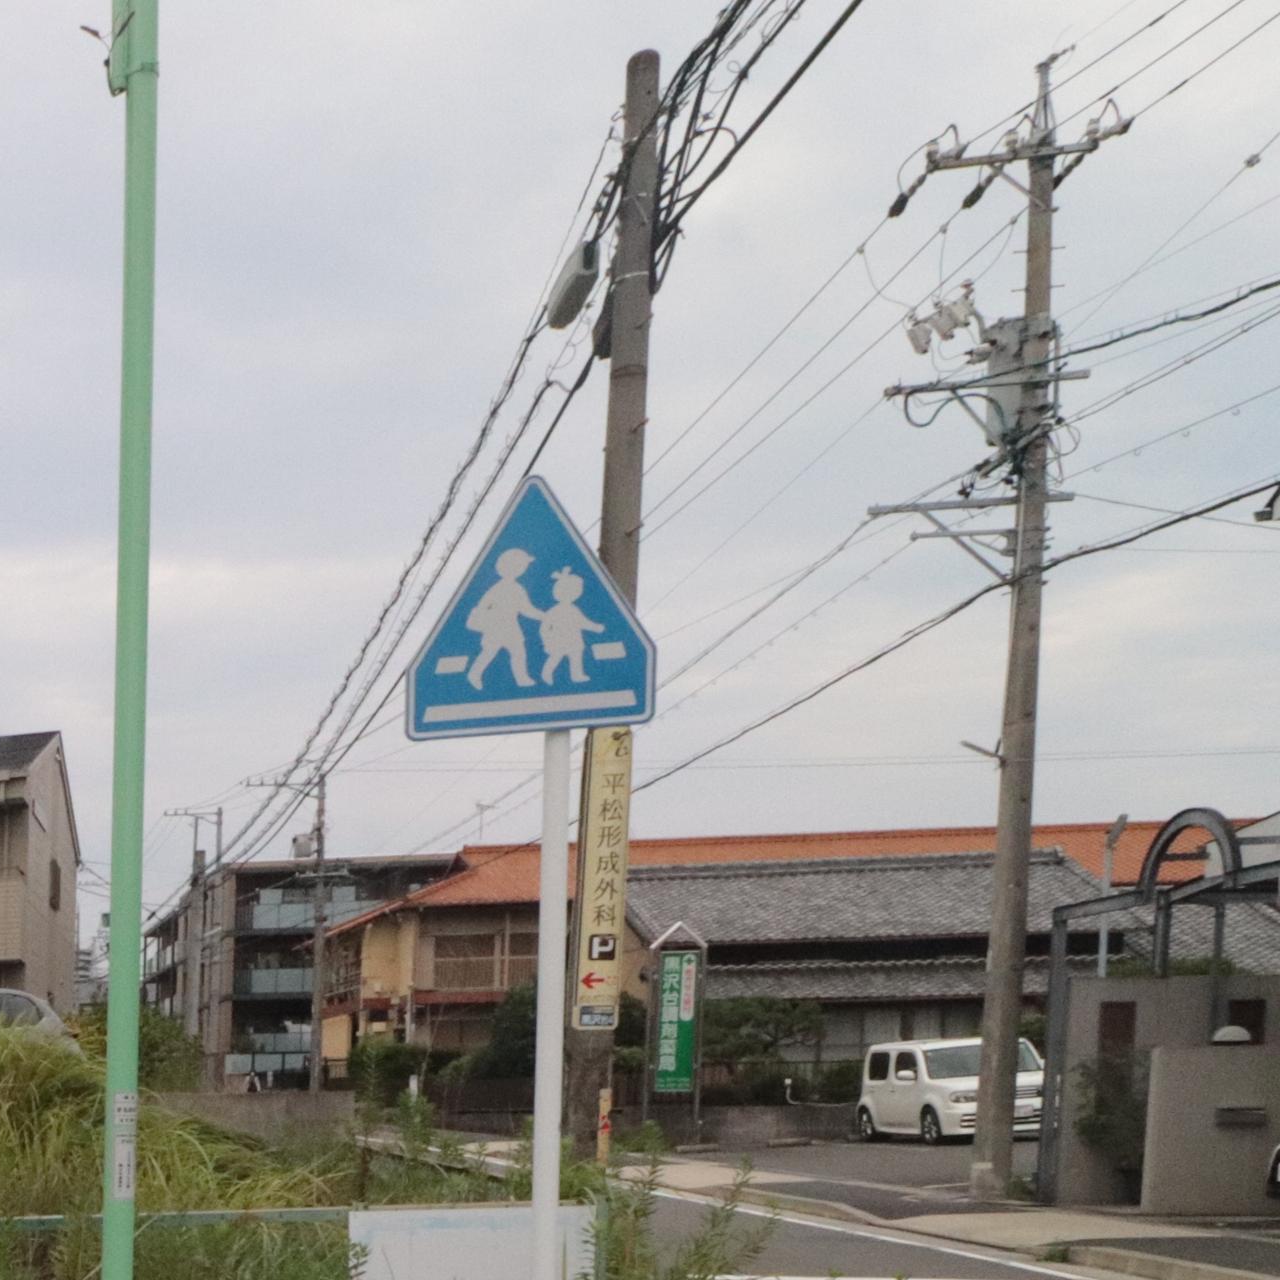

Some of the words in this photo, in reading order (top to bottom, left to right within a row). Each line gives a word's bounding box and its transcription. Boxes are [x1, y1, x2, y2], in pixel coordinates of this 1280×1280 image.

[593, 773, 625, 927] 平松形成外科
